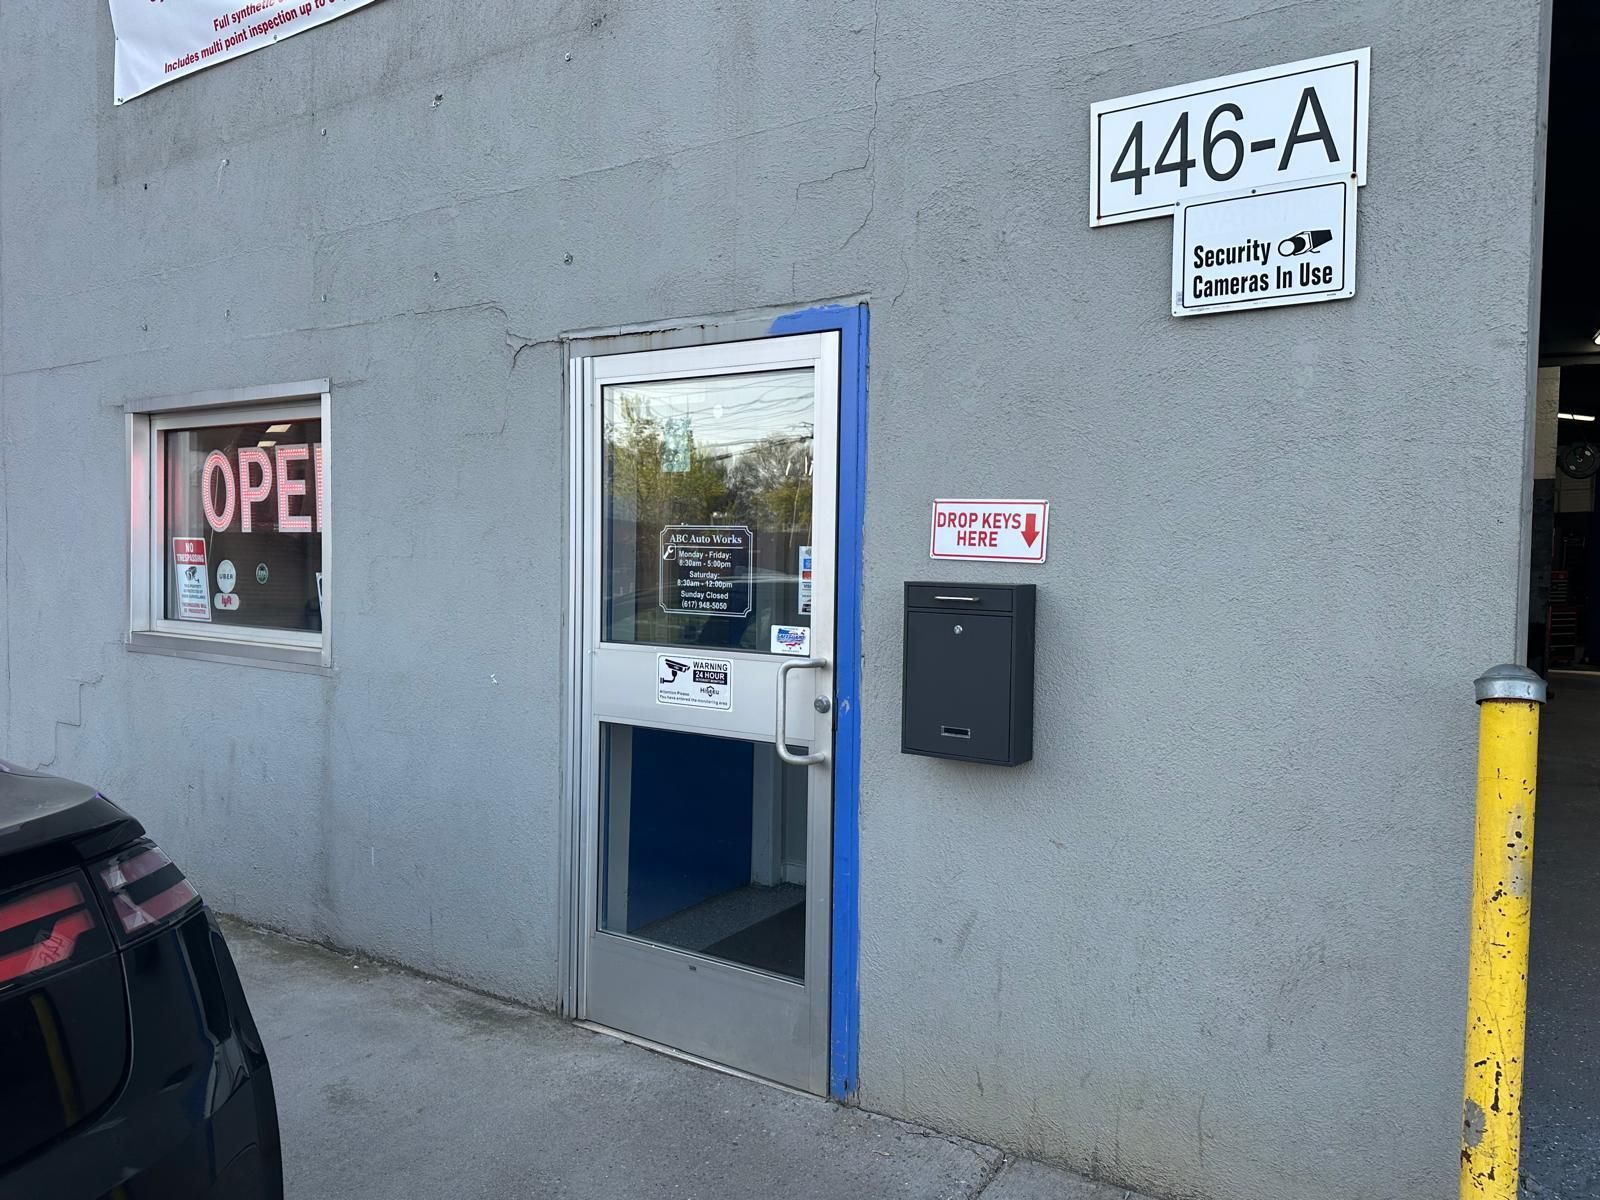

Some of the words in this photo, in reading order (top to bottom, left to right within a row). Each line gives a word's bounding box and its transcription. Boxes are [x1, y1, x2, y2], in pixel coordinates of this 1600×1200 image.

[213, 14, 230, 31] Full
[231, 0, 275, 24] synthetic
[164, 53, 200, 74] Includes
[200, 39, 223, 58] multi
[224, 28, 248, 51] point
[248, 8, 298, 38] inspection
[299, 2, 312, 16] up
[1110, 86, 1341, 196] 446-A
[1193, 238, 1271, 269] Security
[1193, 273, 1269, 299] Cameras
[1276, 266, 1293, 290] In
[1300, 262, 1333, 287] Use
[937, 512, 978, 529] DROP
[981, 513, 1021, 530] KEYS
[669, 534, 688, 543] ABC
[689, 534, 710, 543] Auto
[712, 534, 742, 544] Works
[957, 530, 998, 547] HERE
[185, 542, 194, 553] NO
[678, 550, 703, 559] Monday
[709, 551, 732, 560] Friday:
[689, 571, 720, 580] Saturday:
[705, 580, 733, 589] 12:00pm
[680, 590, 705, 600] Sunday
[706, 592, 729, 600] Closed
[681, 599, 698, 608] (617)
[693, 661, 728, 672] WARNING
[704, 672, 725, 680] HOUR
